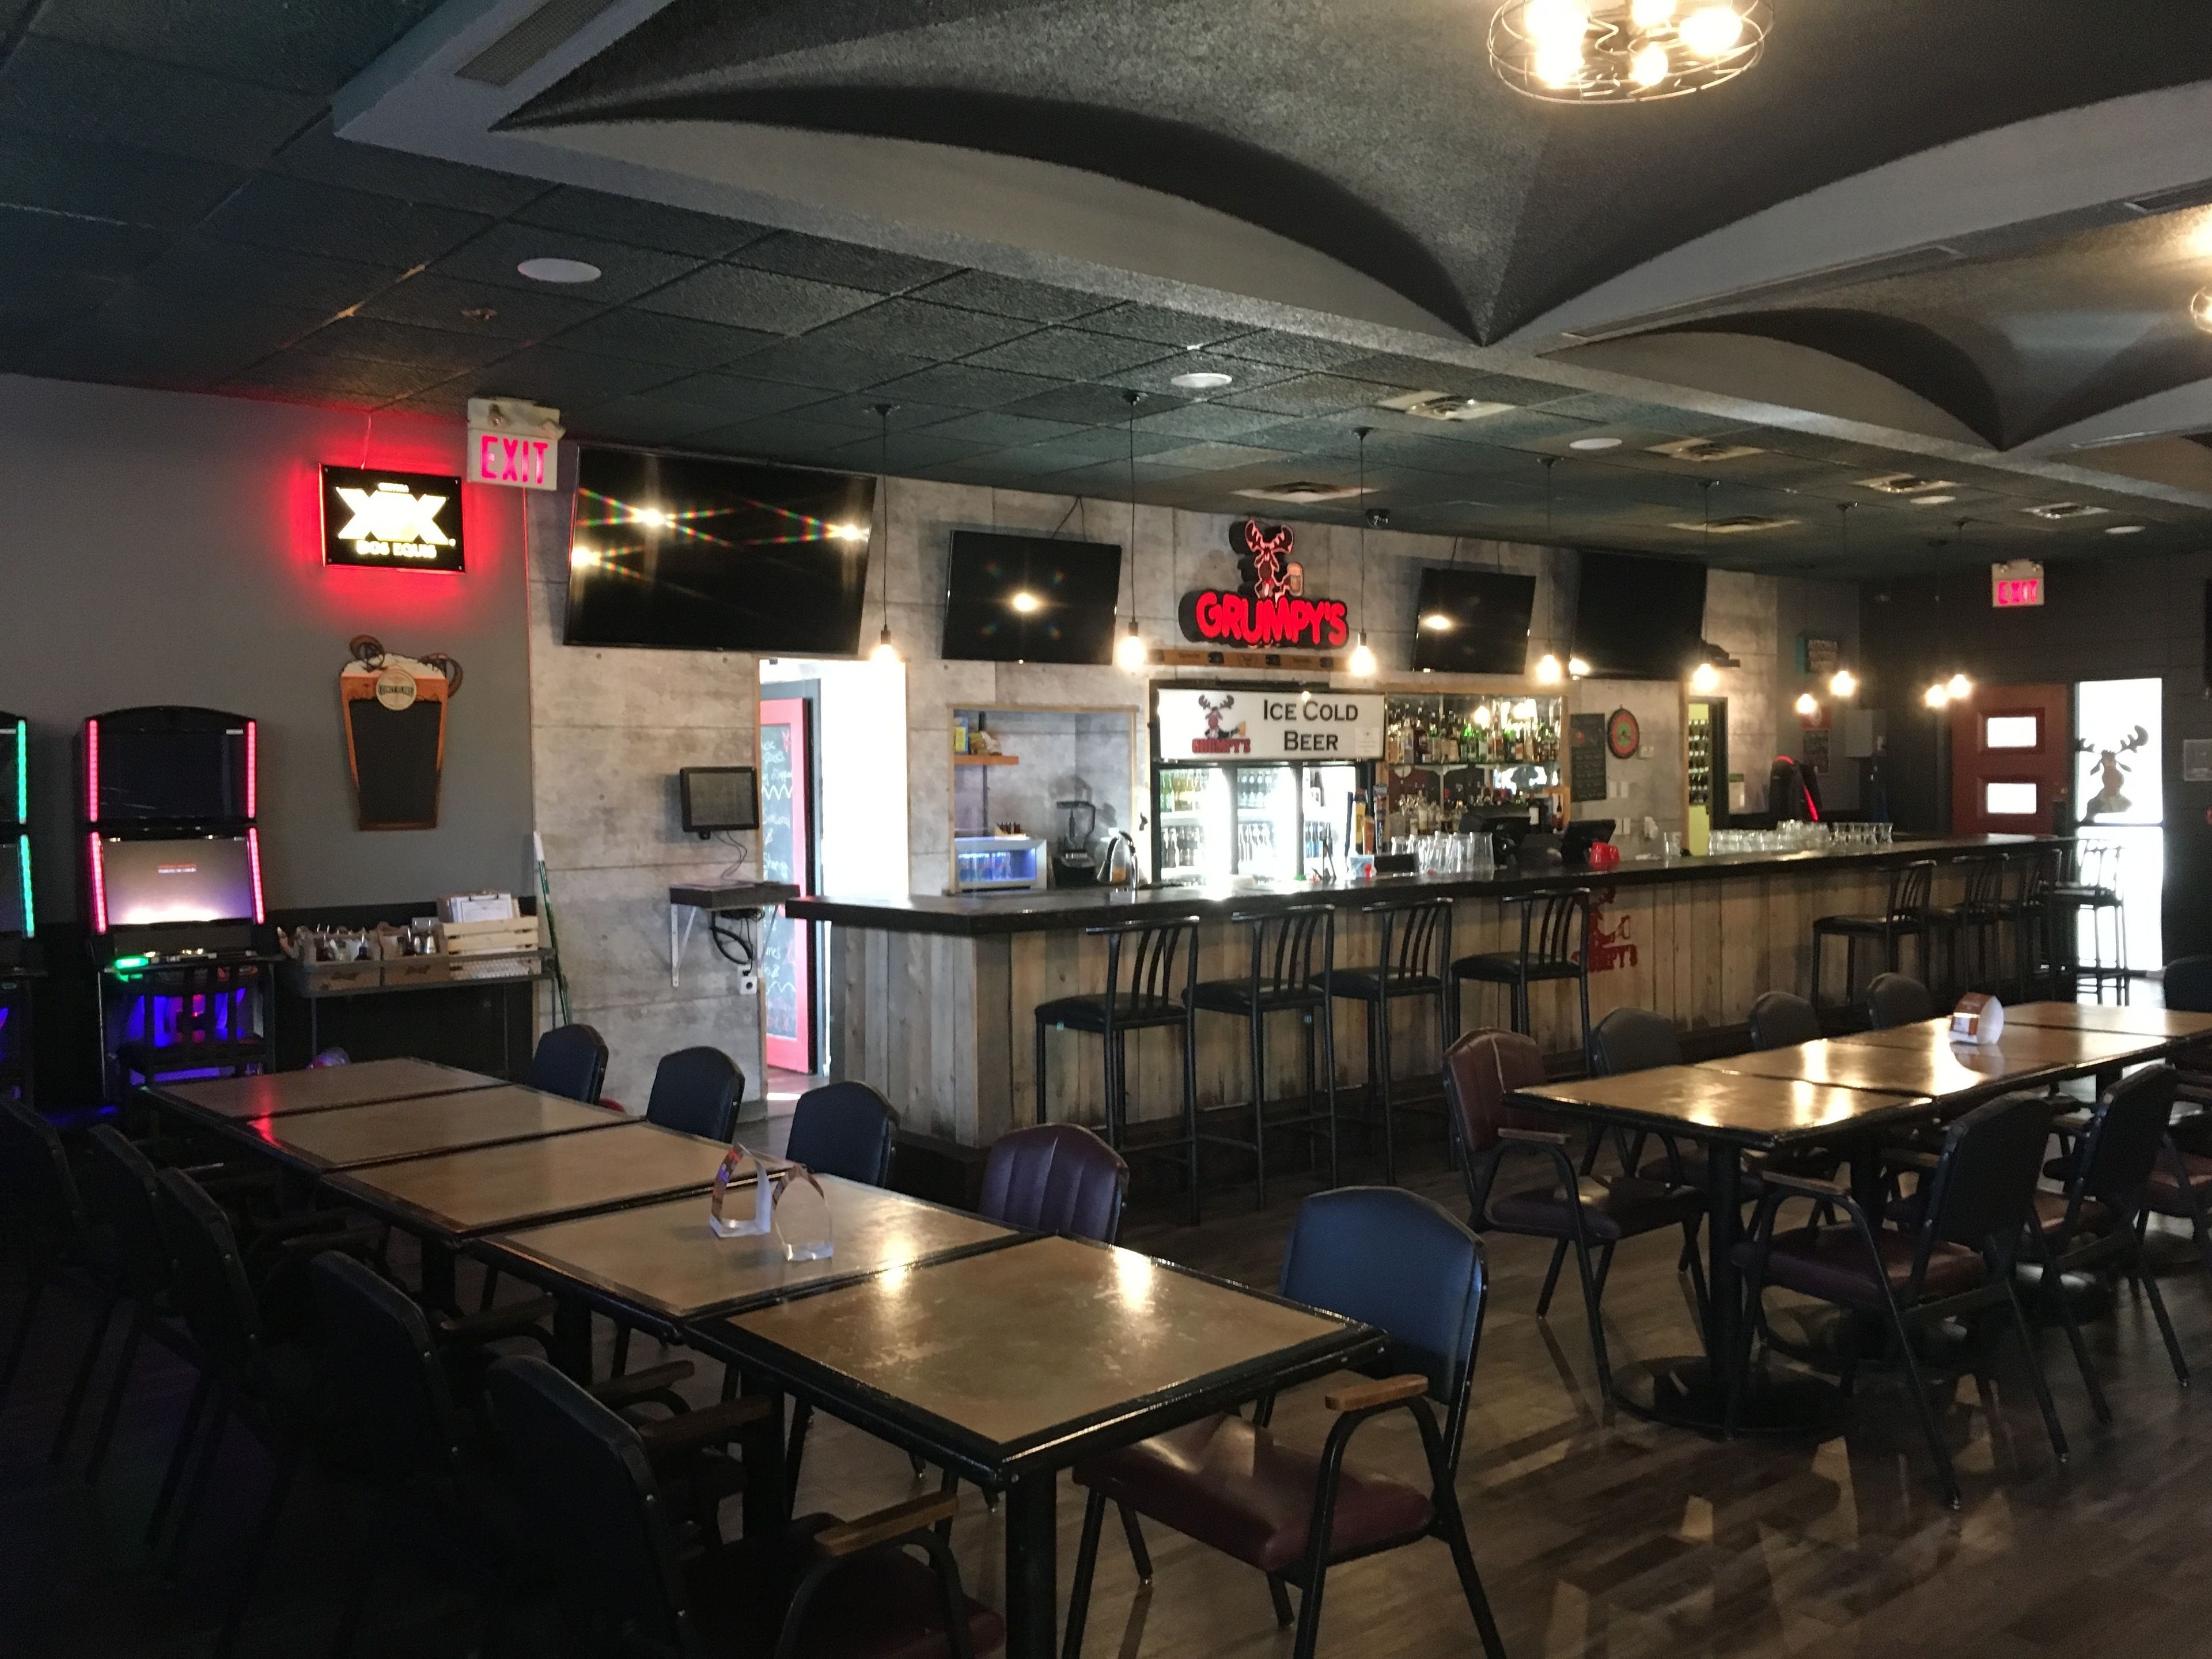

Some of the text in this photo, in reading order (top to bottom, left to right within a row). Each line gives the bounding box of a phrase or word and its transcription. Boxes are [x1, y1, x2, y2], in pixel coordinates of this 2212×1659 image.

[479, 434, 549, 485] EXIT
[355, 539, 390, 555] DOS
[1998, 579, 2038, 605] EXIT
[1196, 592, 1346, 646] GRUMPY'S
[1263, 699, 1359, 722] ICE COLD
[1283, 730, 1339, 752] BEER
